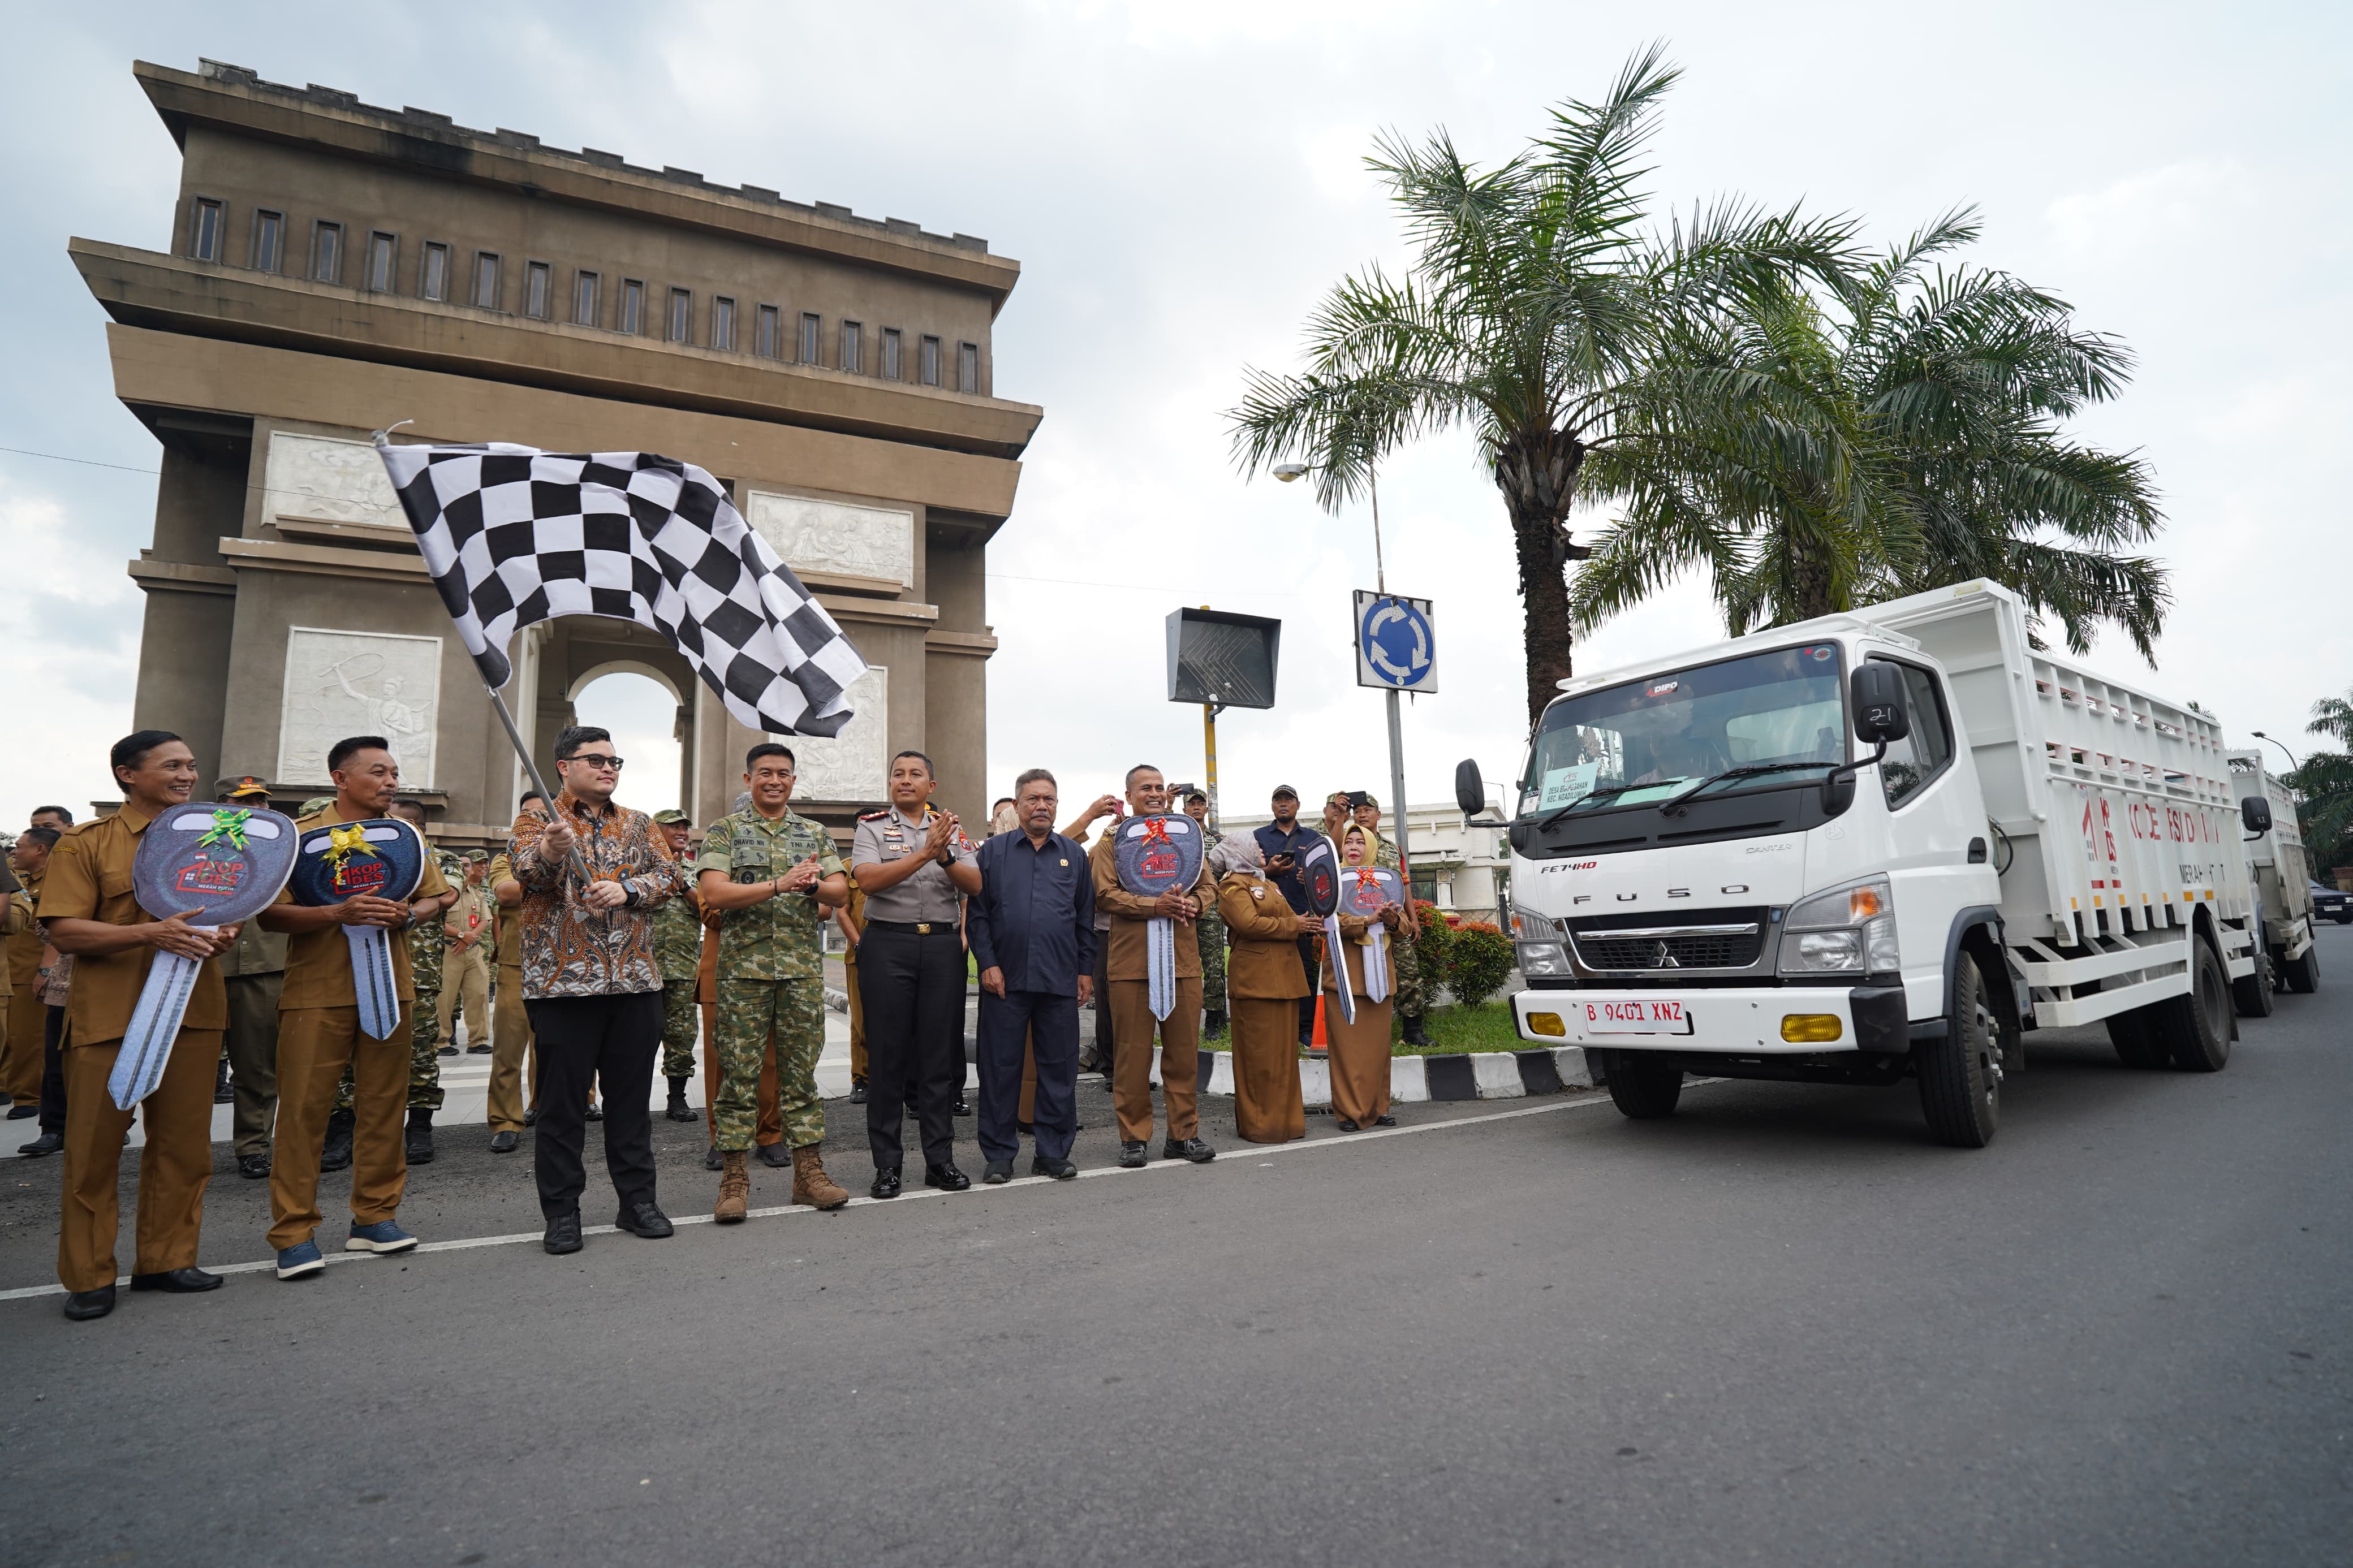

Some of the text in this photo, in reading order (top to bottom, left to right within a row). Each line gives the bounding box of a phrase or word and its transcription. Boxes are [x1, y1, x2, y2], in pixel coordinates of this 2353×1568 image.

[1654, 681, 1678, 693] DIPO
[1869, 707, 1891, 722] 21
[1546, 790, 1587, 804] KEC. NGADILUWIH
[1549, 787, 1559, 795] DESA
[1745, 843, 1792, 854] CANTER
[205, 861, 244, 874] KOP
[351, 862, 383, 876] KOP
[1155, 862, 1176, 870] DES
[1541, 861, 1597, 874] FE74HD
[200, 874, 239, 886] DES
[352, 872, 383, 885] DES
[1574, 883, 1749, 905] FUSO
[1587, 1003, 1683, 1021] B 9401 XNZ
